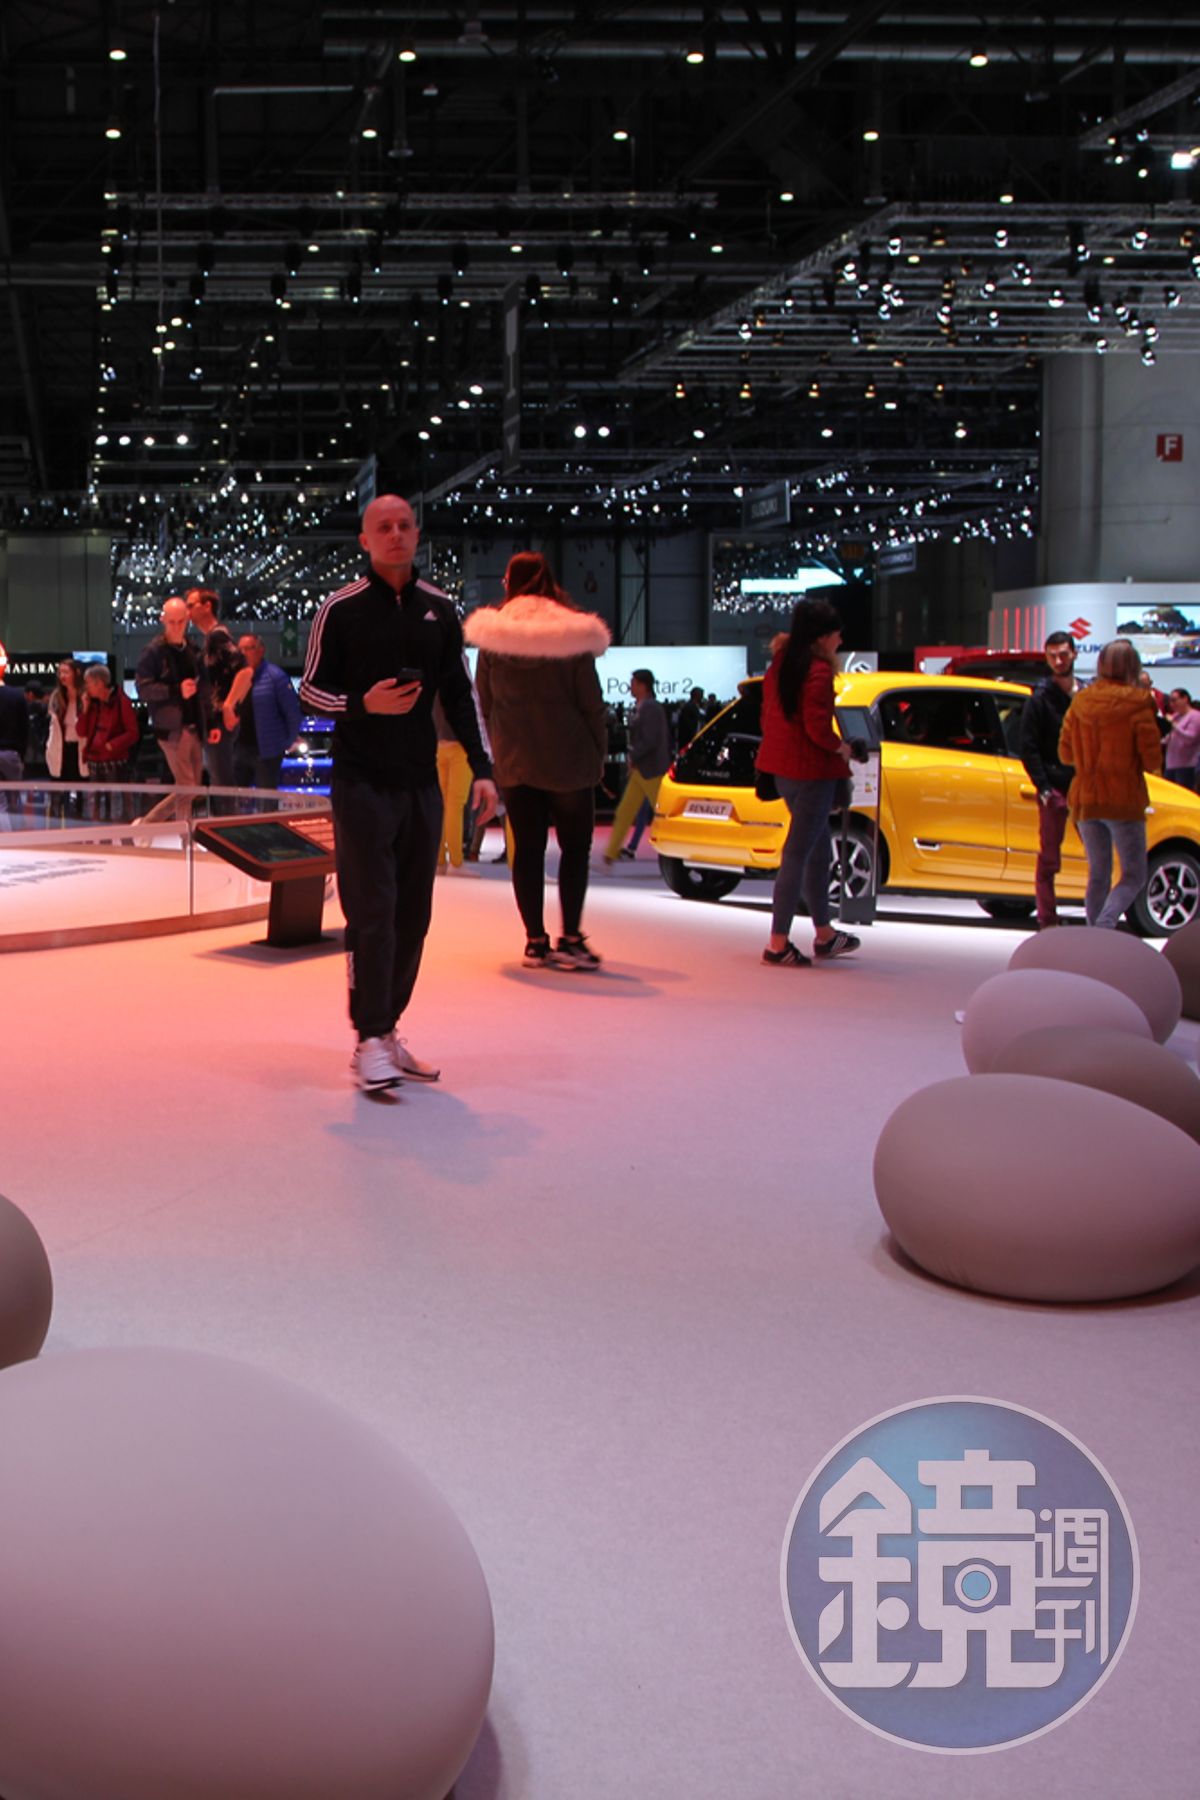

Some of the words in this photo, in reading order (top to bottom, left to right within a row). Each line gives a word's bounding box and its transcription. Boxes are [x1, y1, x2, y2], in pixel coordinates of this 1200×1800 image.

[1165, 436, 1178, 456] F
[682, 677, 694, 694] 2
[688, 802, 726, 817] RENAULT
